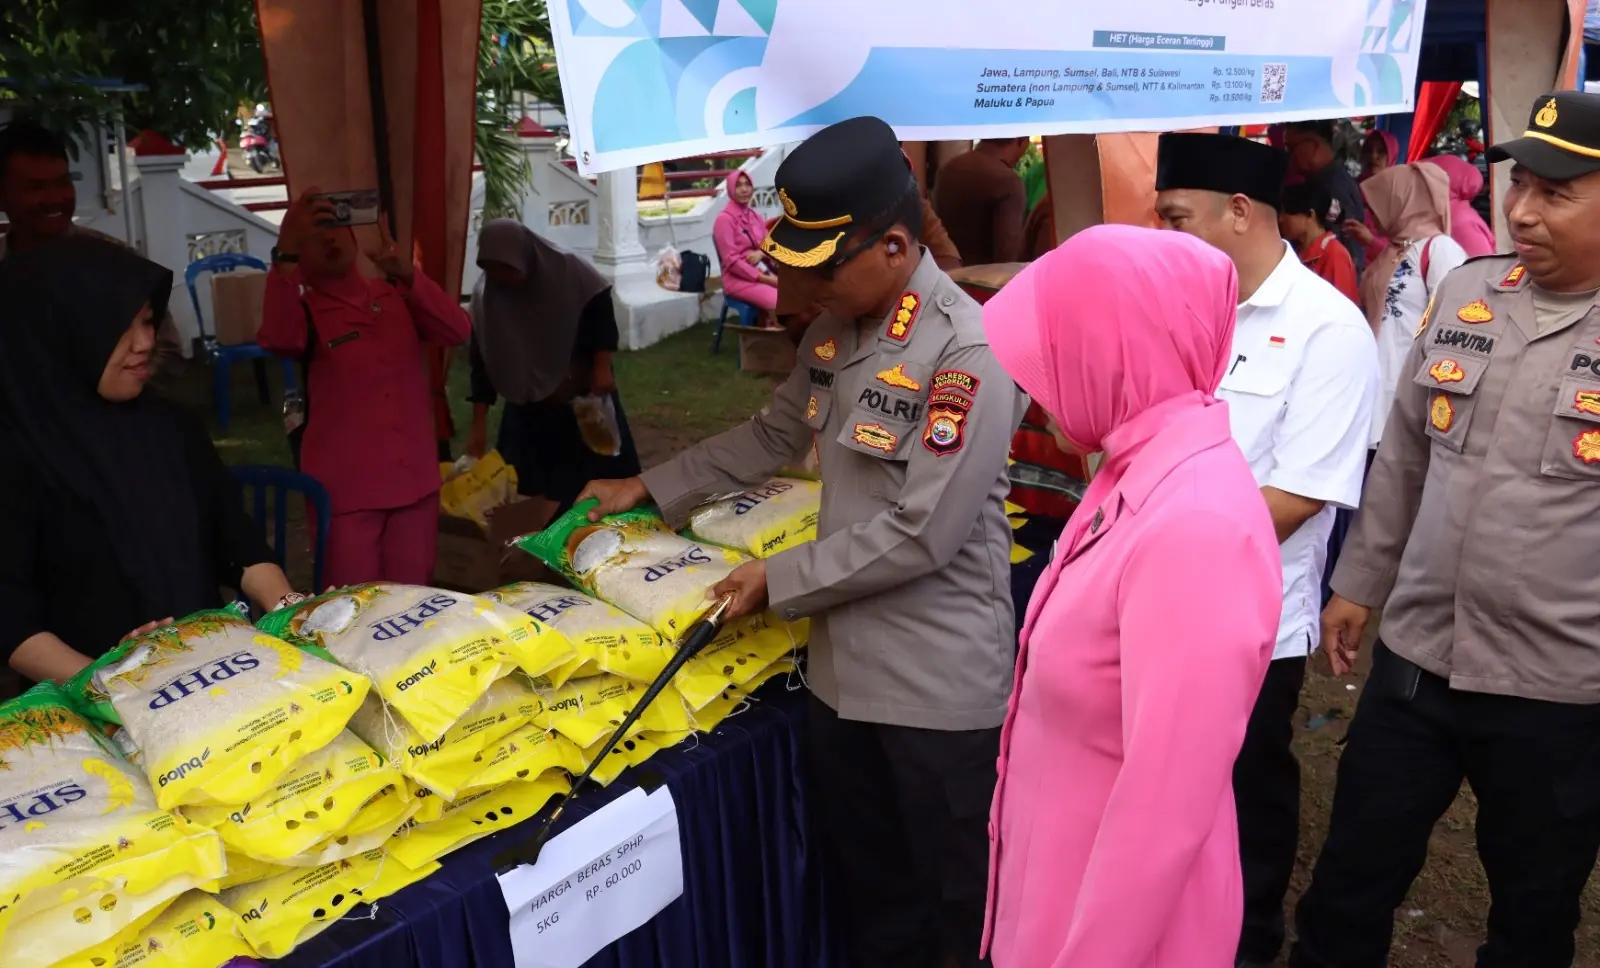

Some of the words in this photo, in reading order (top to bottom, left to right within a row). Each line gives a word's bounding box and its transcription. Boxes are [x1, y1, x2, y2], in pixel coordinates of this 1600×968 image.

[1108, 33, 1126, 43] HET
[1127, 34, 1153, 45] (Harga
[1155, 35, 1179, 45] Eceran
[980, 67, 1011, 78] Jawa,
[1014, 67, 1061, 79] Lampung,
[1063, 68, 1099, 78] Sumsel,
[1101, 68, 1119, 78] Bali,
[1121, 68, 1139, 77] NTB
[1140, 68, 1146, 77] &
[1148, 68, 1181, 77] Sulawesi
[976, 83, 1026, 93] Sumatera
[1029, 83, 1050, 93] (non
[1053, 83, 1094, 93] Lampung
[1096, 83, 1103, 91] &
[1142, 82, 1159, 90] NTT
[1160, 82, 1165, 90] &
[1168, 82, 1205, 90] Kalimantan
[974, 98, 1013, 108] Maluku
[1016, 97, 1022, 107] &
[1025, 97, 1055, 108] Papua
[1434, 328, 1493, 354] S.SAPUTRA
[935, 373, 971, 384] POLRESTA
[858, 388, 918, 420] POLRI
[932, 394, 968, 406] BENGKULU
[371, 595, 457, 642] SPHP
[149, 652, 260, 710] SPHP
[396, 665, 434, 692] bulog
[158, 756, 201, 788] bulog
[531, 881, 572, 912] HARGA
[577, 854, 611, 883] BERAS
[617, 834, 644, 859] SPHP
[536, 912, 559, 934] 5KG
[586, 886, 603, 901] RP.
[605, 859, 642, 888] 60.000
